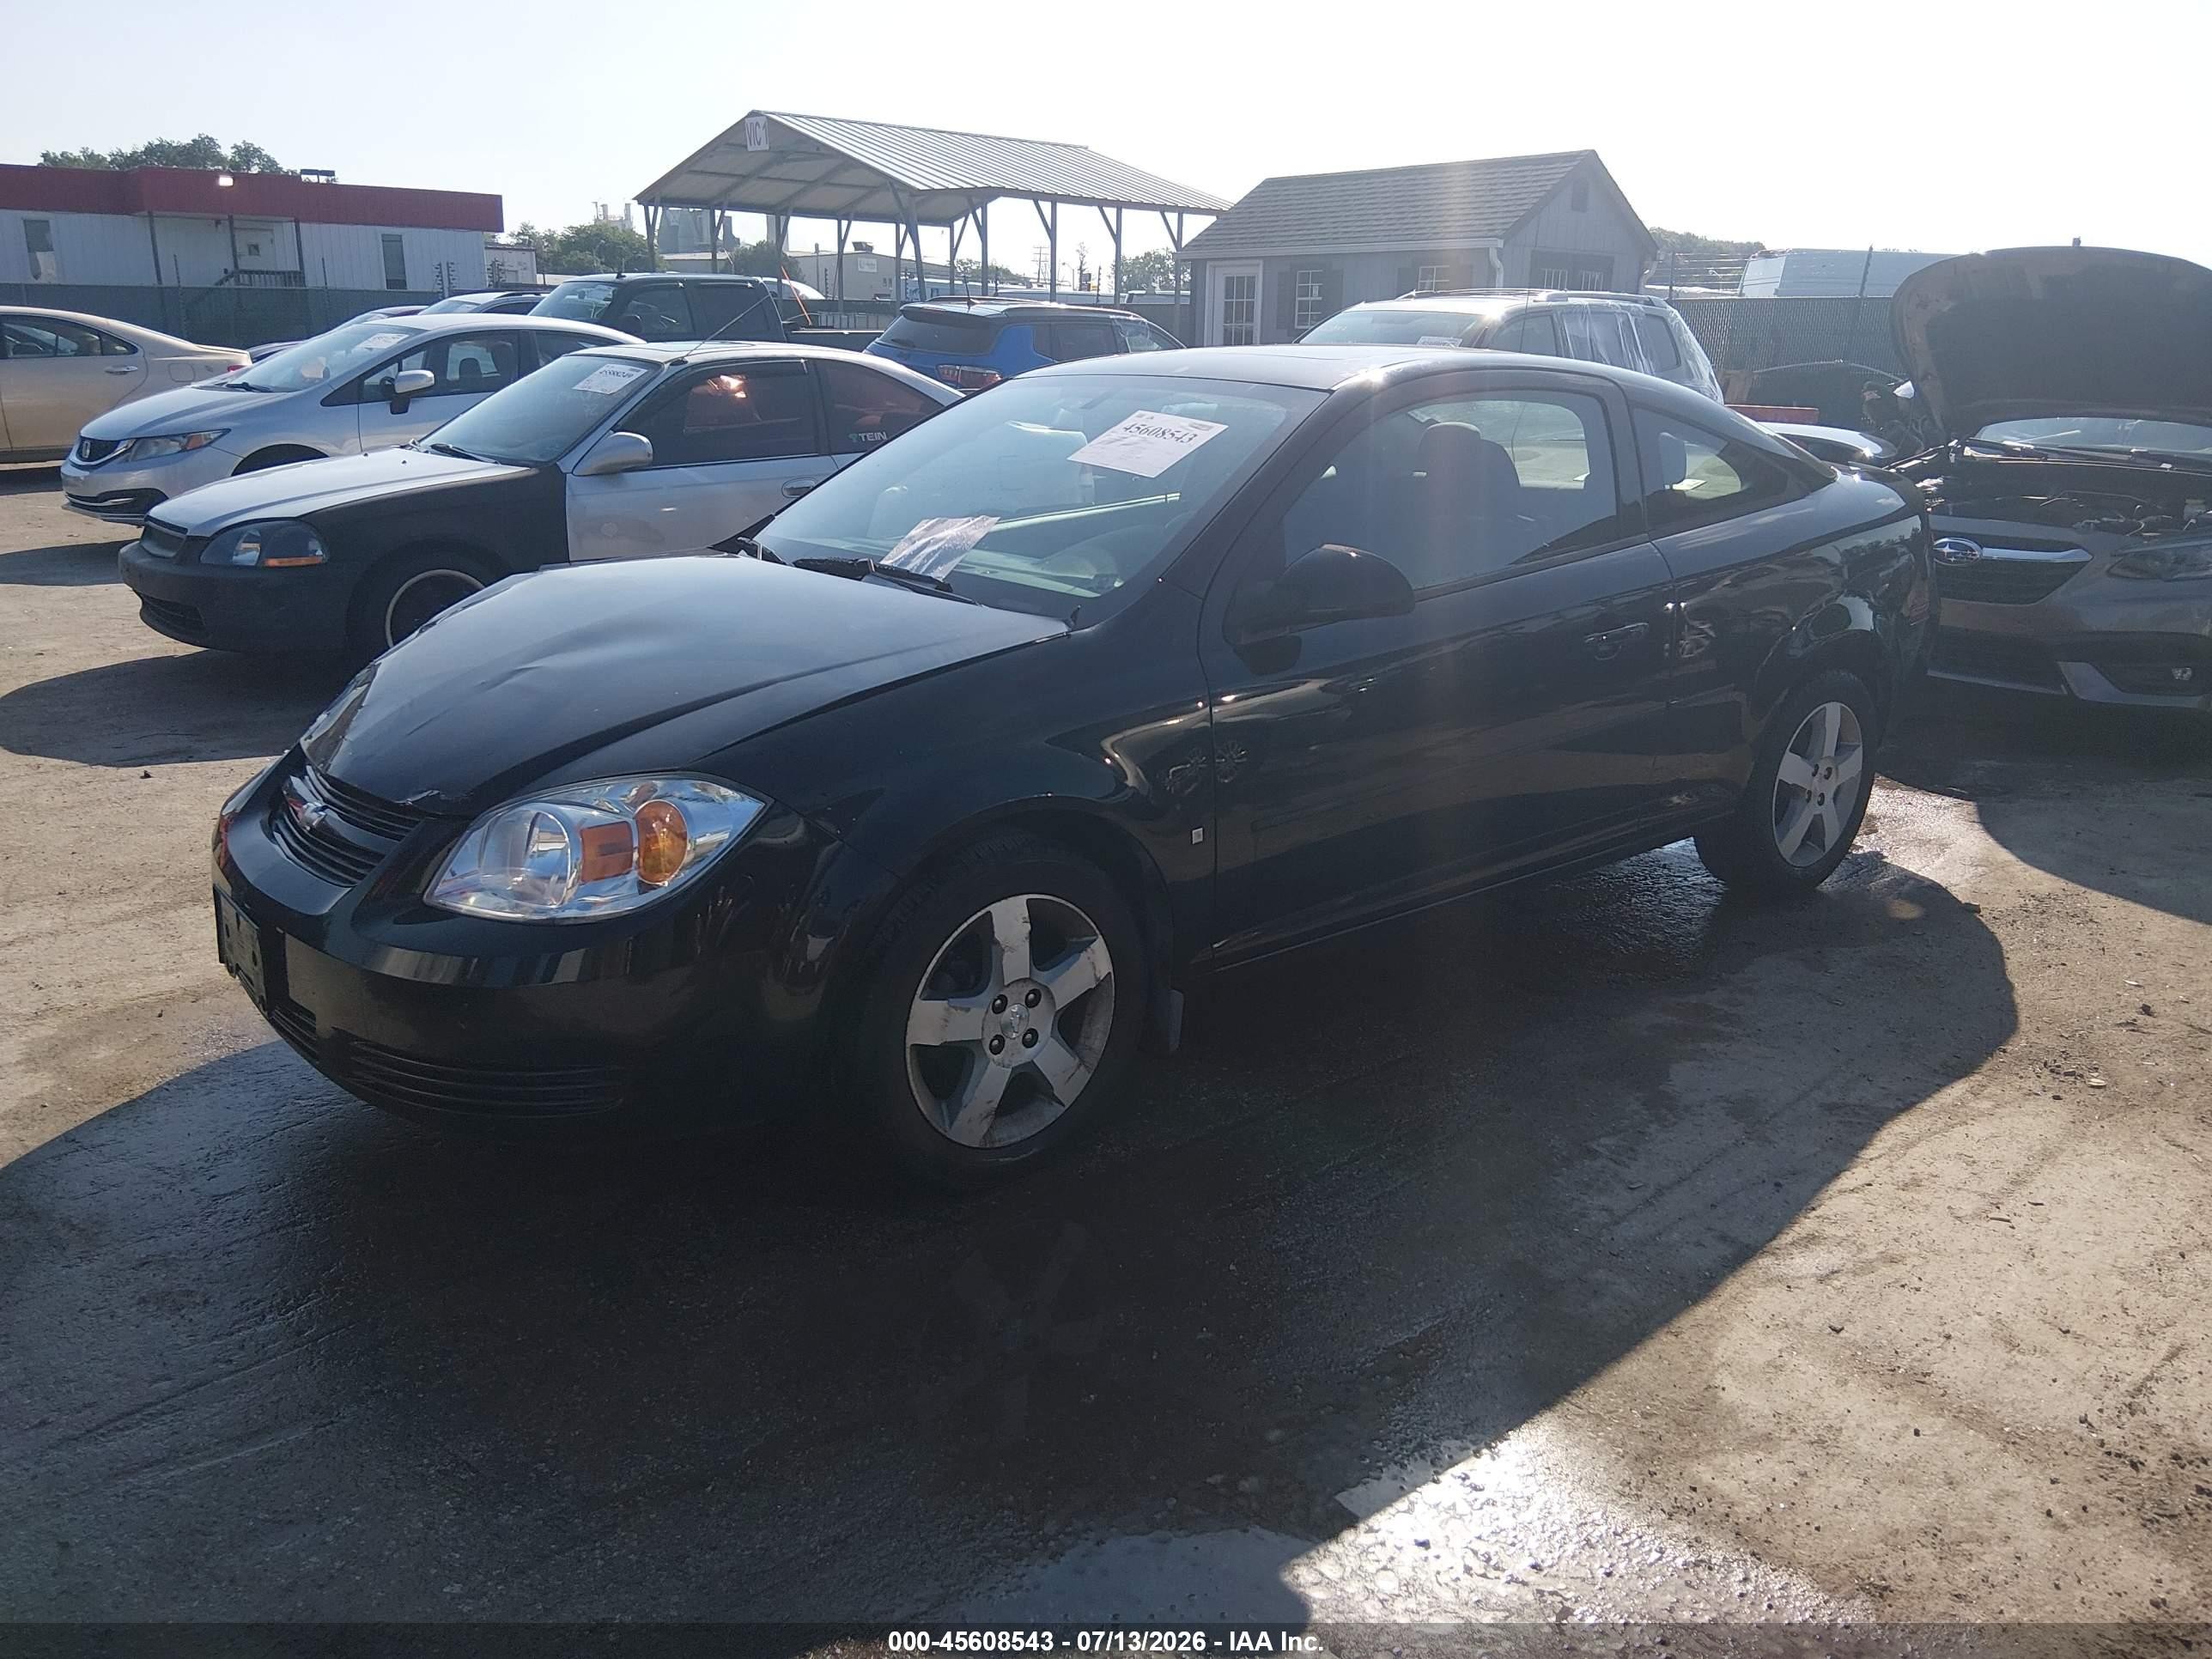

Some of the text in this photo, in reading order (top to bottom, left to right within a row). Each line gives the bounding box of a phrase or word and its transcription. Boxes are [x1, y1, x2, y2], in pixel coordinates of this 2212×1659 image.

[746, 120, 769, 147] VIC 1
[858, 431, 888, 442] TEIN
[1123, 422, 1199, 444] 45608543
